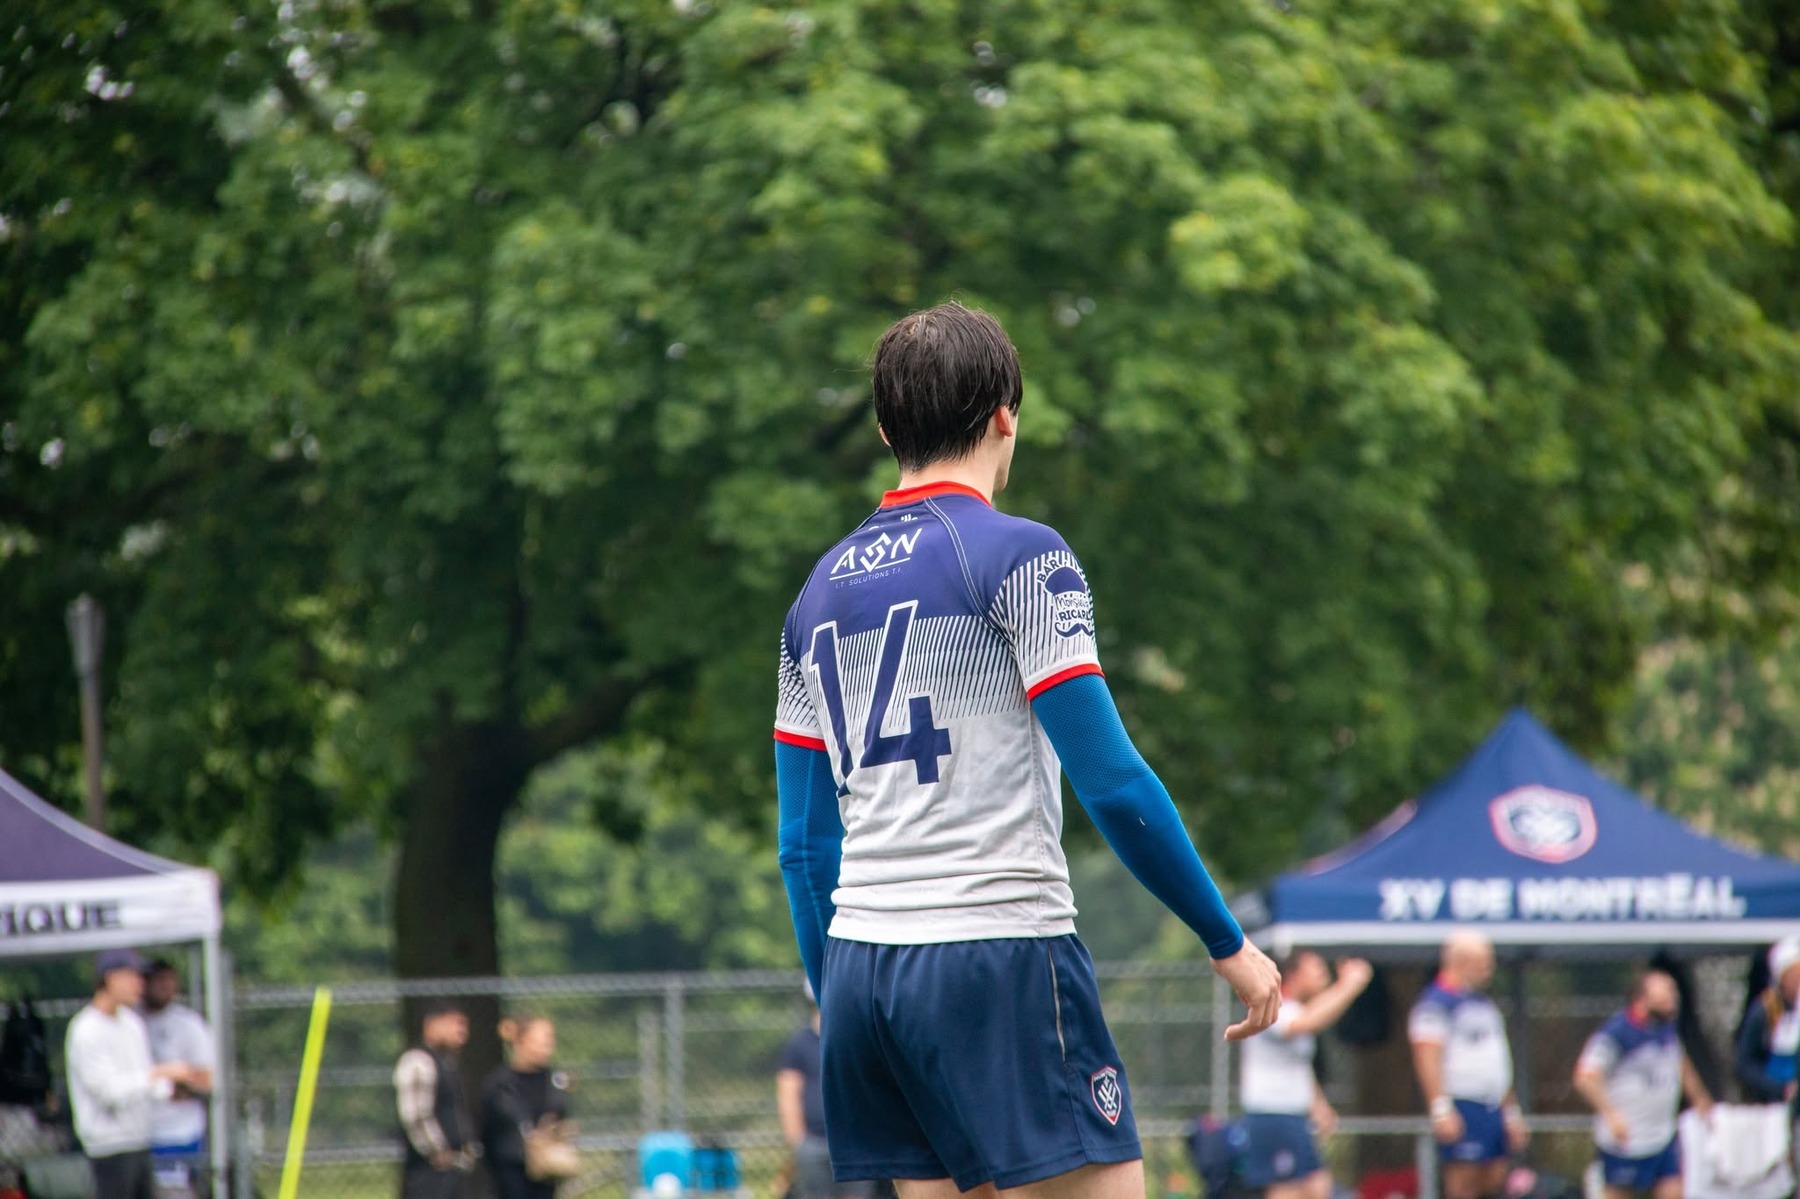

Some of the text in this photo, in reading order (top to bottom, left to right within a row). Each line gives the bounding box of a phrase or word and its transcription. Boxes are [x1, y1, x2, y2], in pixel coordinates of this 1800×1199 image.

[848, 569, 890, 586] SOLUTIONS
[1036, 559, 1060, 583] BAR
[809, 600, 952, 798] 14
[1379, 878, 1445, 921] XV
[1450, 878, 1514, 921] DE
[0, 900, 121, 937] IQUE
